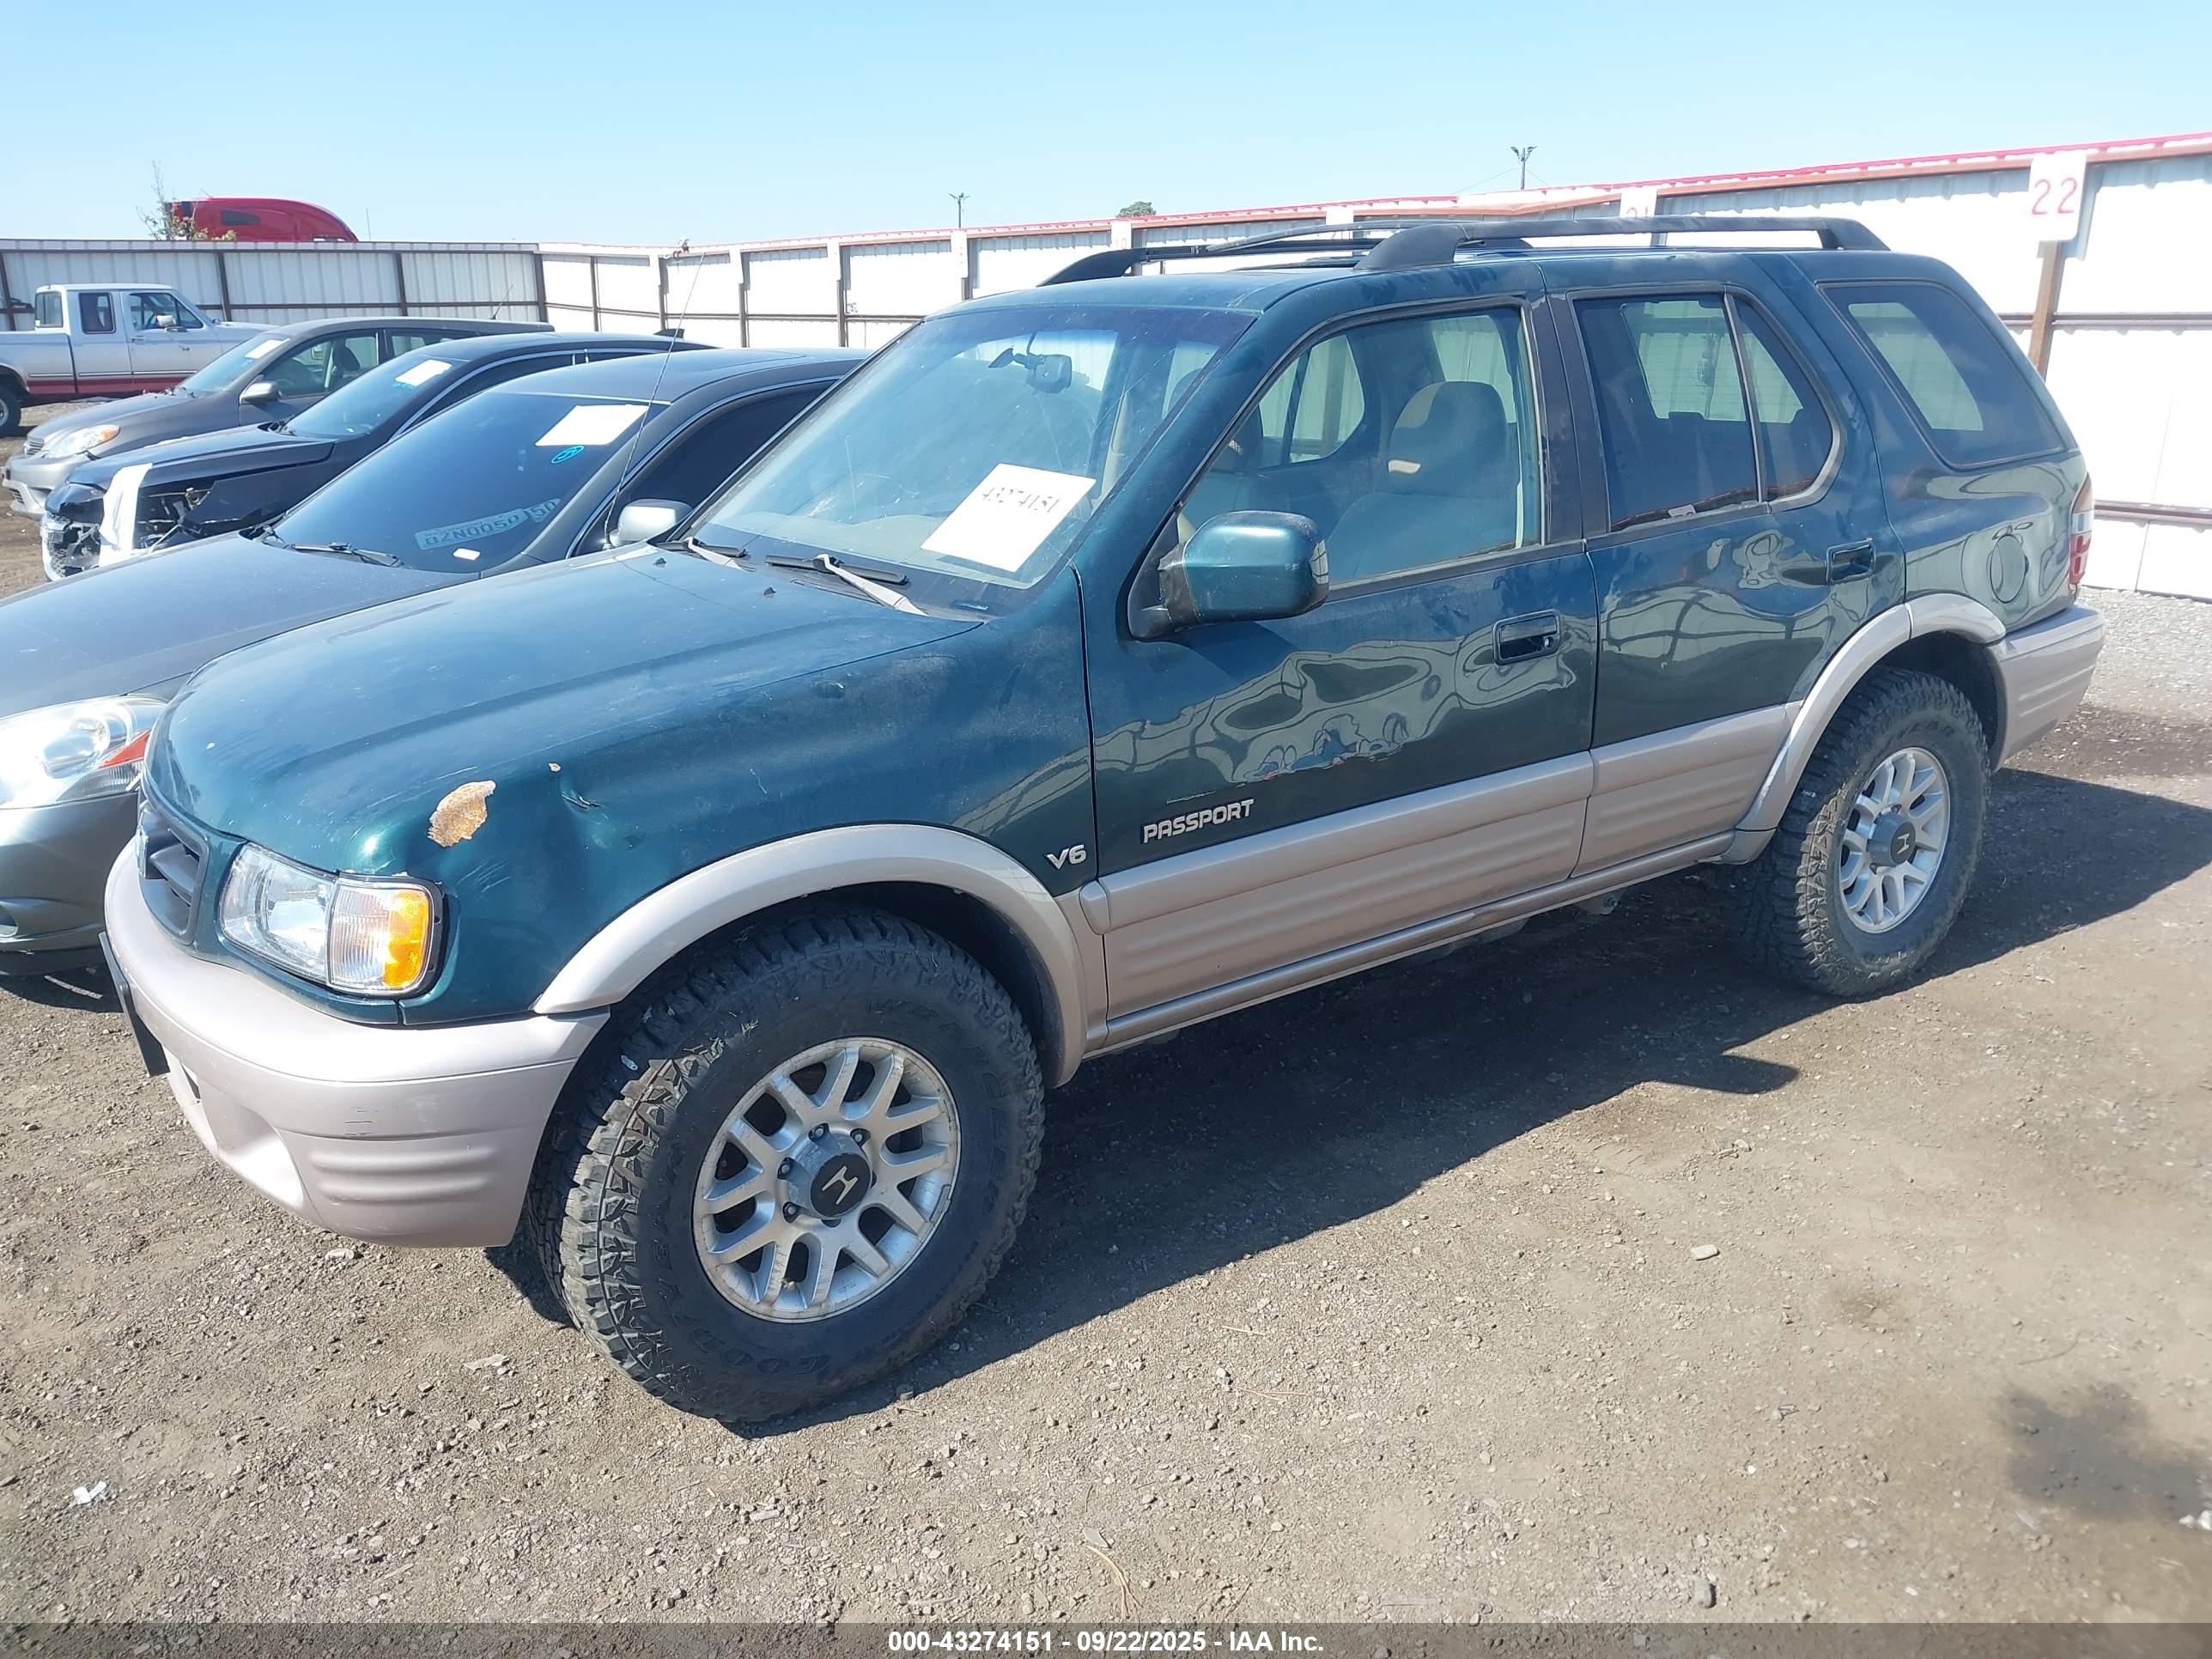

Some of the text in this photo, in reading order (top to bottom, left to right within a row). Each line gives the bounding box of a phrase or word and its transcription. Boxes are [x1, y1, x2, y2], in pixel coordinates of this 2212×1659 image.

[2032, 177, 2078, 215] 22
[1143, 799, 1255, 843] PASSPORT
[1047, 844, 1086, 870] V6
